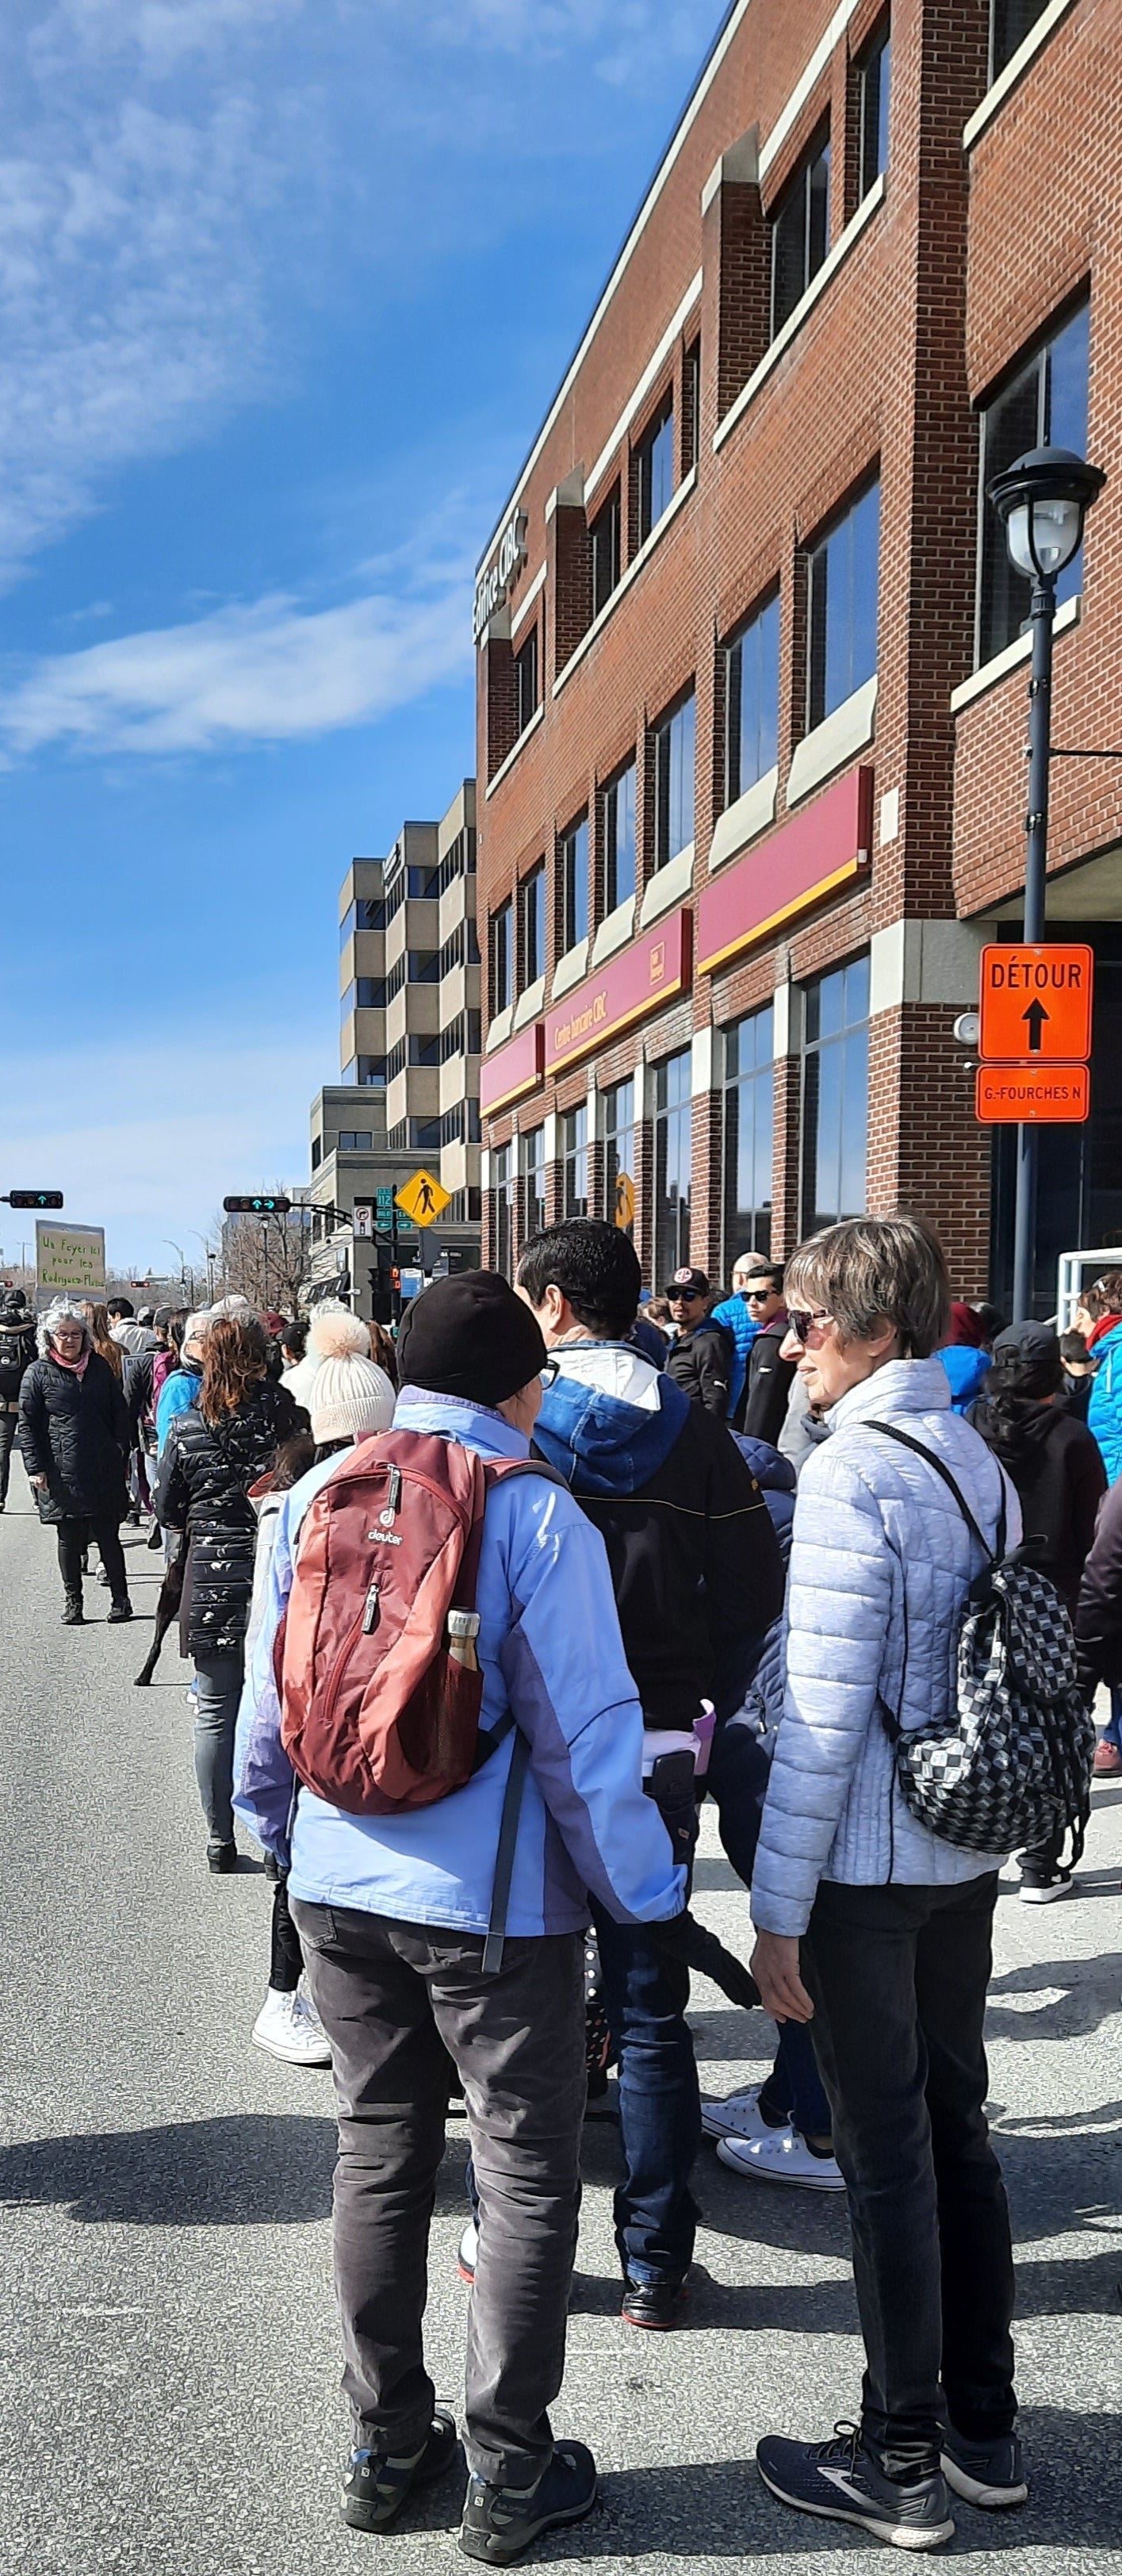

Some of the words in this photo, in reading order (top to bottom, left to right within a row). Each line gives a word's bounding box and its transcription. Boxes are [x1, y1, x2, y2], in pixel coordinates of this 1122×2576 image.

[991, 956, 1082, 989] DÉTOUR
[984, 1086, 1069, 1100] G.-FOURCHES
[1072, 1086, 1081, 1099] N
[378, 1194, 391, 1205] 112
[52, 1256, 74, 1267] pour
[80, 1258, 94, 1268] les
[368, 1528, 403, 1546] deuter
